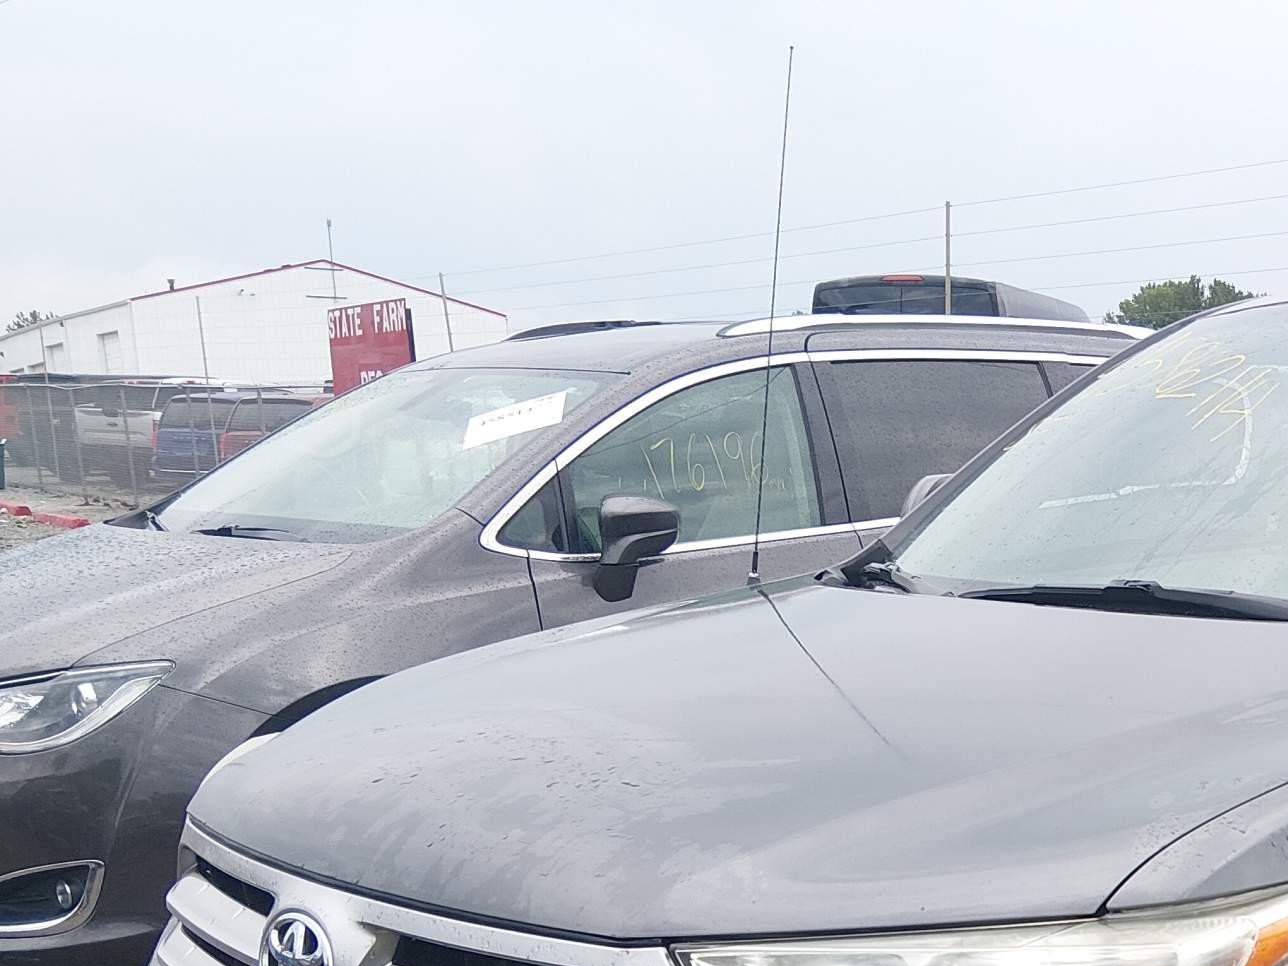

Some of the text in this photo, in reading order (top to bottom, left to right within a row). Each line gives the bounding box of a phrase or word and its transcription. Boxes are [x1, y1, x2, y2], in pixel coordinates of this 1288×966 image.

[328, 300, 407, 339] STATE FARM
[640, 431, 769, 499] 176196
